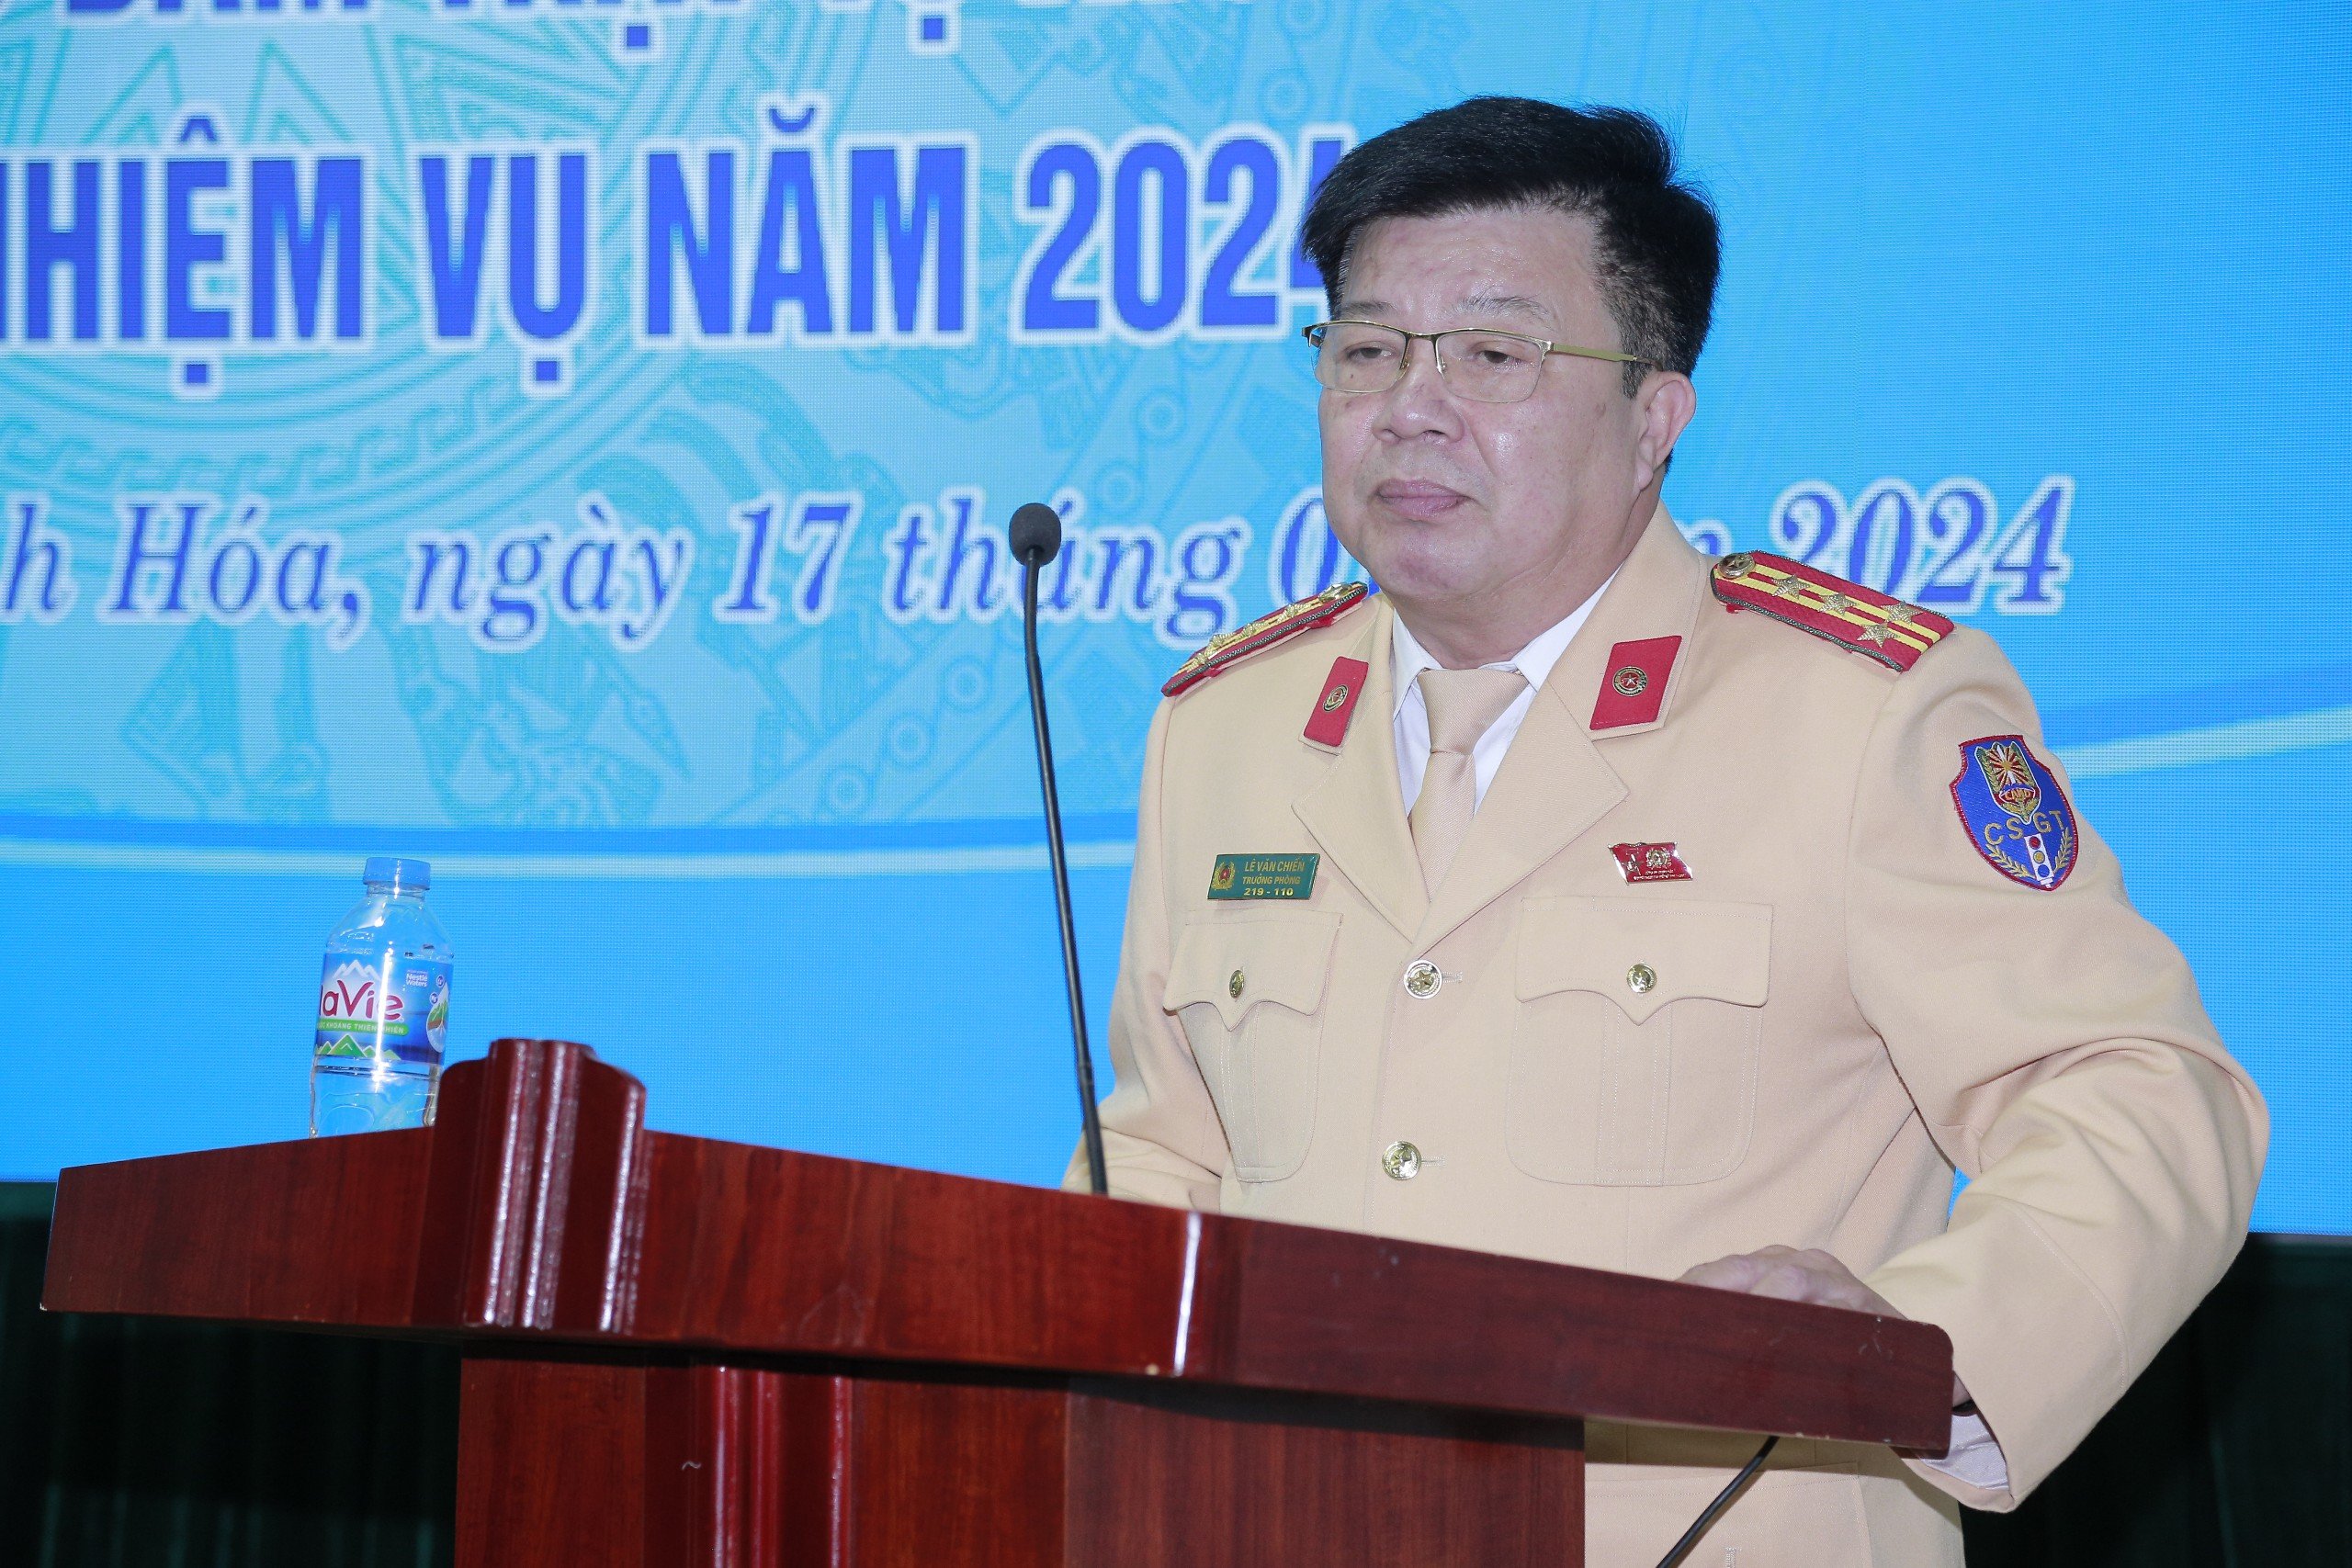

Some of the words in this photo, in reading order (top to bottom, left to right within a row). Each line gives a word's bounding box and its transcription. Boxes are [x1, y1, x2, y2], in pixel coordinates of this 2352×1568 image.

[0, 117, 364, 384] HIỆM
[420, 153, 586, 382] VỤ
[648, 107, 966, 335] NĂM
[110, 504, 358, 639] Hóa,
[413, 502, 684, 641] ngày
[726, 505, 852, 612] 17
[894, 496, 1243, 637] tháng
[1281, 497, 1380, 604] 0
[1782, 490, 2063, 604] 2024
[1243, 887, 1264, 896] 219
[1274, 887, 1294, 896] 110
[1244, 858, 1256, 872] LÊ
[1257, 858, 1277, 872] VĂN
